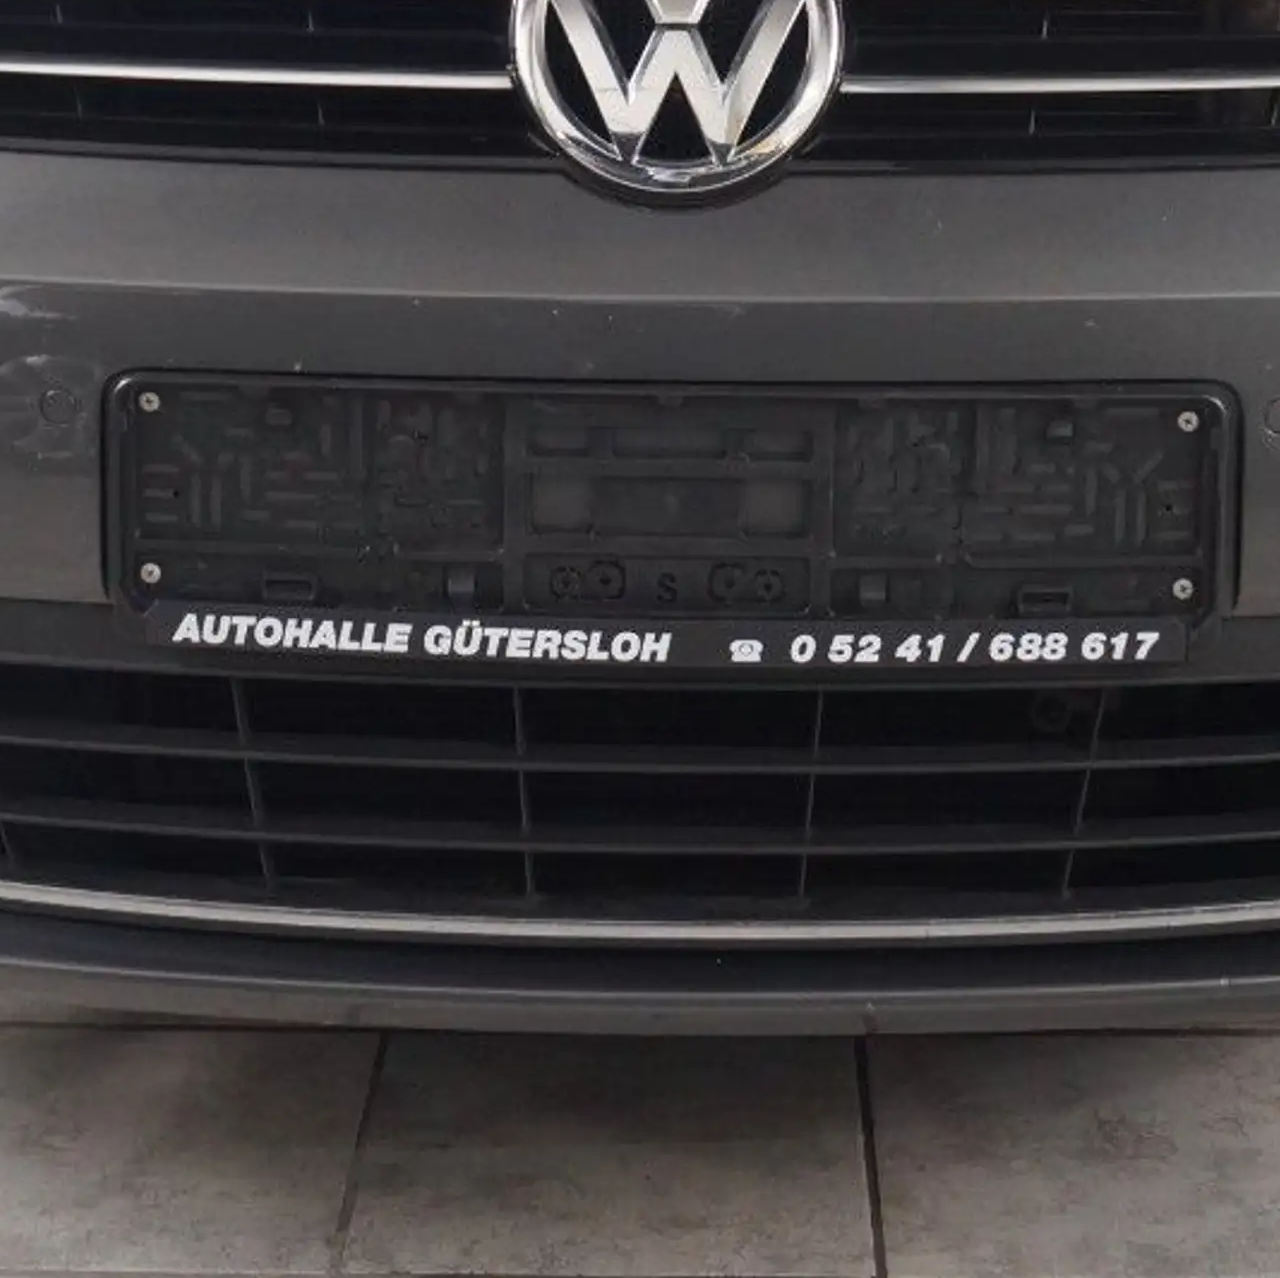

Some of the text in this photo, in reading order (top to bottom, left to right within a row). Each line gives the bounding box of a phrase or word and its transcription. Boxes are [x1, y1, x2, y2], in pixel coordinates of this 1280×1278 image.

[172, 612, 413, 654] AUTOHALLE
[423, 619, 672, 663] GÜTERSLOH
[988, 632, 1069, 662] 688
[1081, 631, 1160, 661] 617
